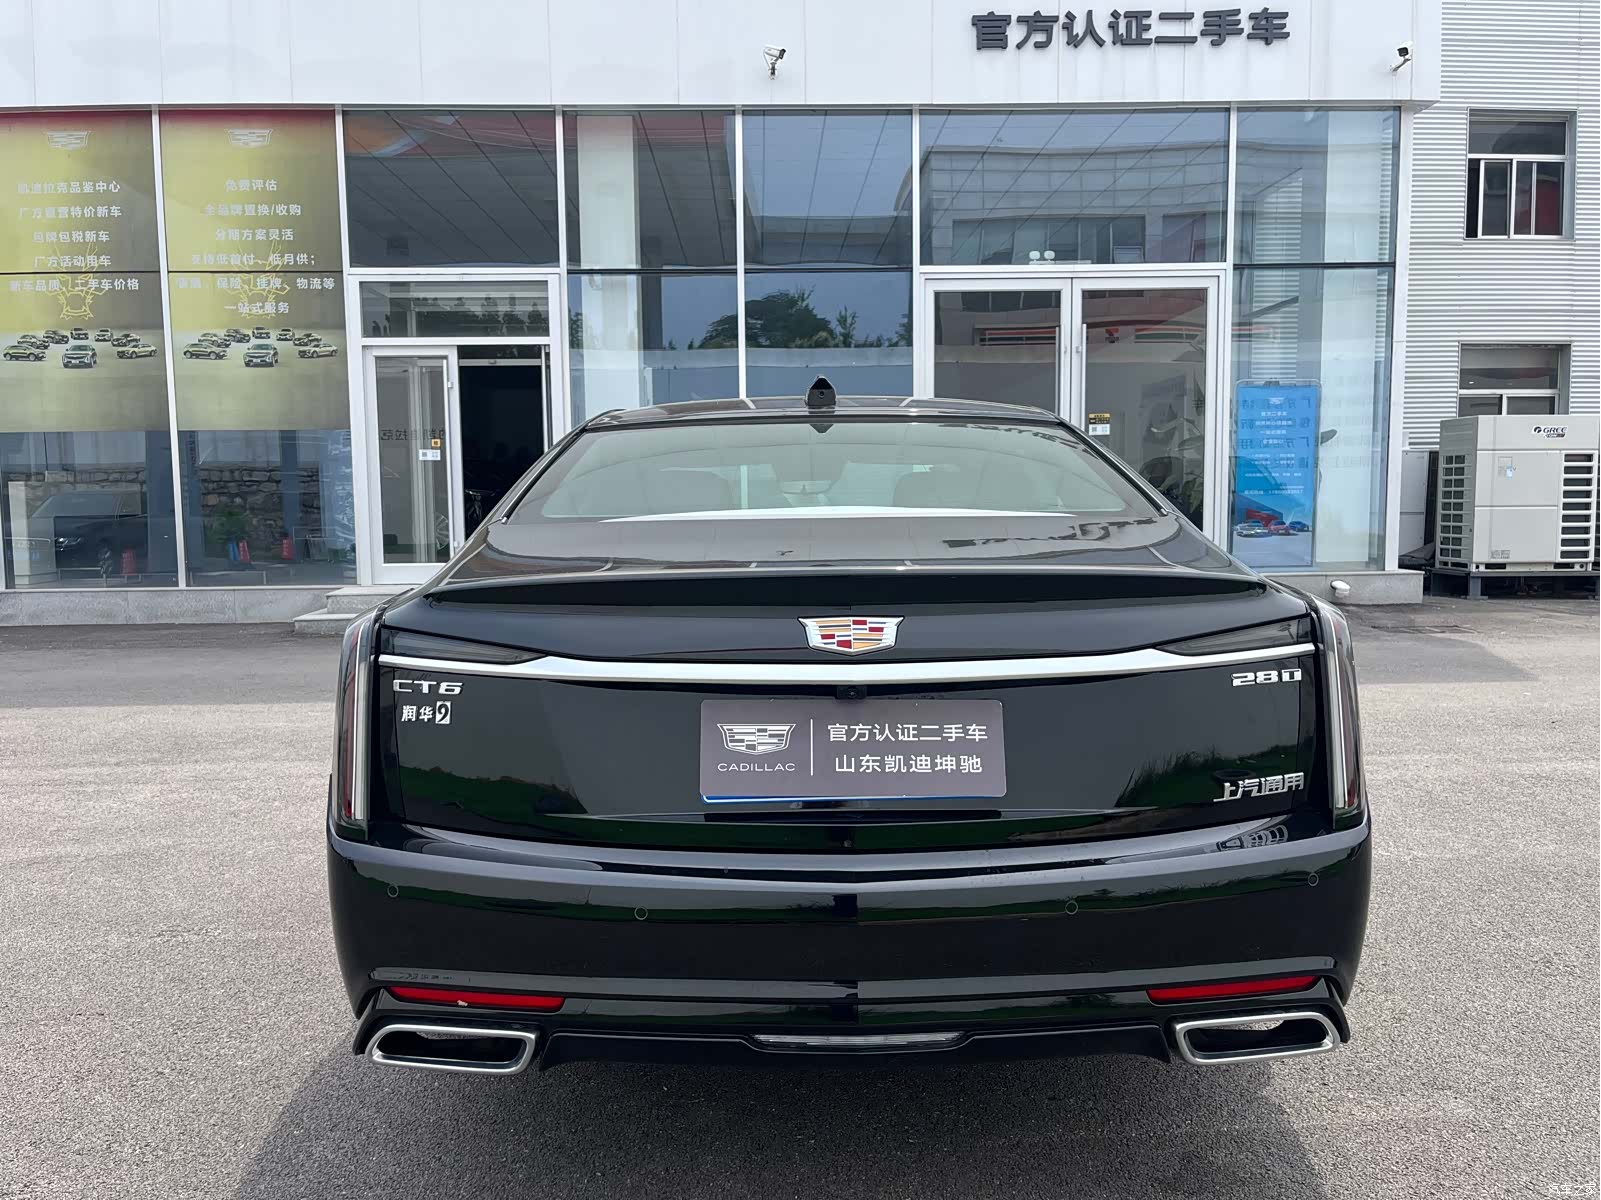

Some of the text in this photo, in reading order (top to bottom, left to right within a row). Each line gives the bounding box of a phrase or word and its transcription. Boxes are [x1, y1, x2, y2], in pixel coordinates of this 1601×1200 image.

[971, 8, 1291, 50] 官方认证二手车
[225, 179, 278, 192] 免费评估
[215, 228, 294, 241] 分期方案灵活
[33, 254, 112, 268] 厂方活动用车
[223, 301, 290, 315] 一站式服务
[1232, 668, 1302, 687] 28T
[393, 679, 464, 695] CT6
[827, 723, 988, 742] 官方认证二手车
[717, 762, 796, 772] CADILLAC
[835, 754, 983, 773] 山东凯迪坤驰
[1213, 772, 1305, 802] 上汽通用
